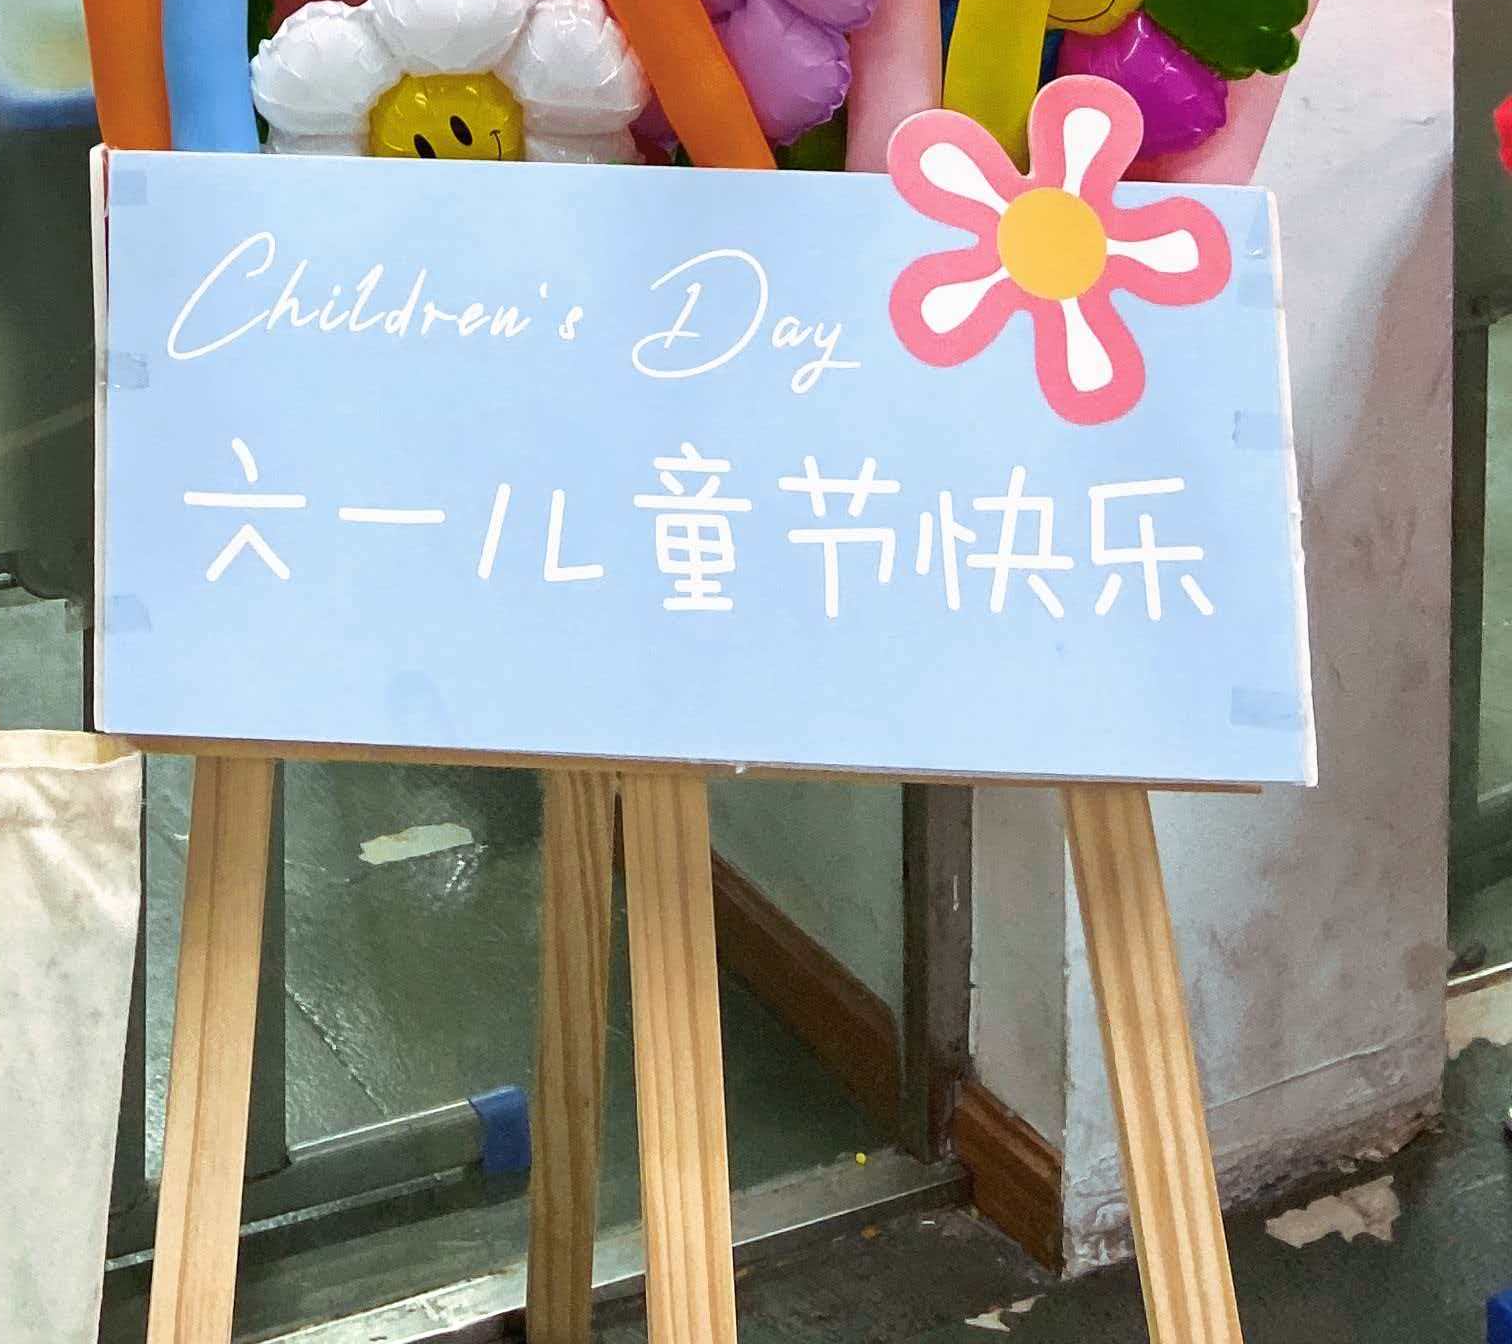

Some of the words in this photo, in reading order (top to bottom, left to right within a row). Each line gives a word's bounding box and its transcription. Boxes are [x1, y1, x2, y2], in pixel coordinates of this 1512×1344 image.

[167, 231, 583, 360] Children's
[631, 249, 862, 394] Day
[183, 436, 1214, 621] 六一儿童节快乐
